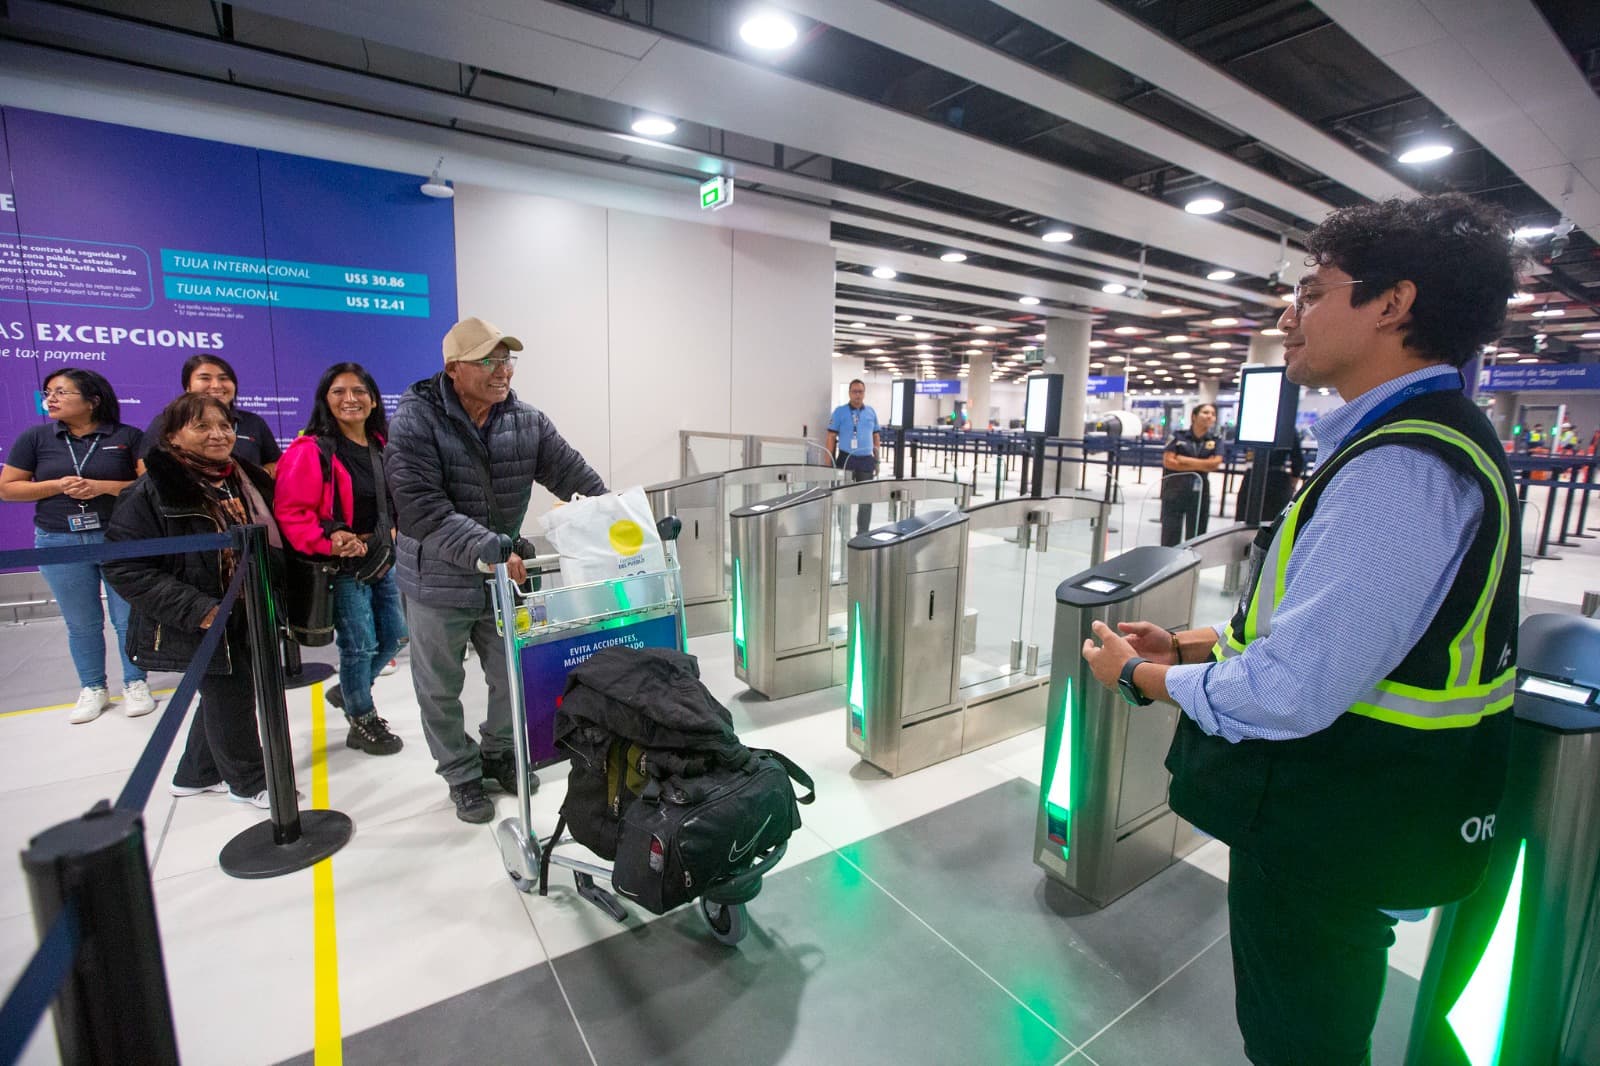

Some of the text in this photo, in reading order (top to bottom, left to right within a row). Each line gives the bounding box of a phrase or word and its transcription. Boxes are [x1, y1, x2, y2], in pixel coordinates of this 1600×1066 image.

[0, 193, 16, 212] E
[30, 246, 62, 254] control
[174, 255, 405, 288] TUUA INTERNACIONAL US$ 30.86
[177, 283, 405, 311] TUUA NACIONAL US$ 12.41
[36, 323, 224, 349] EXCEPCIONES
[15, 347, 39, 358] tax
[44, 350, 106, 362] payment
[569, 633, 638, 656] EVITA ACCIDENTES,
